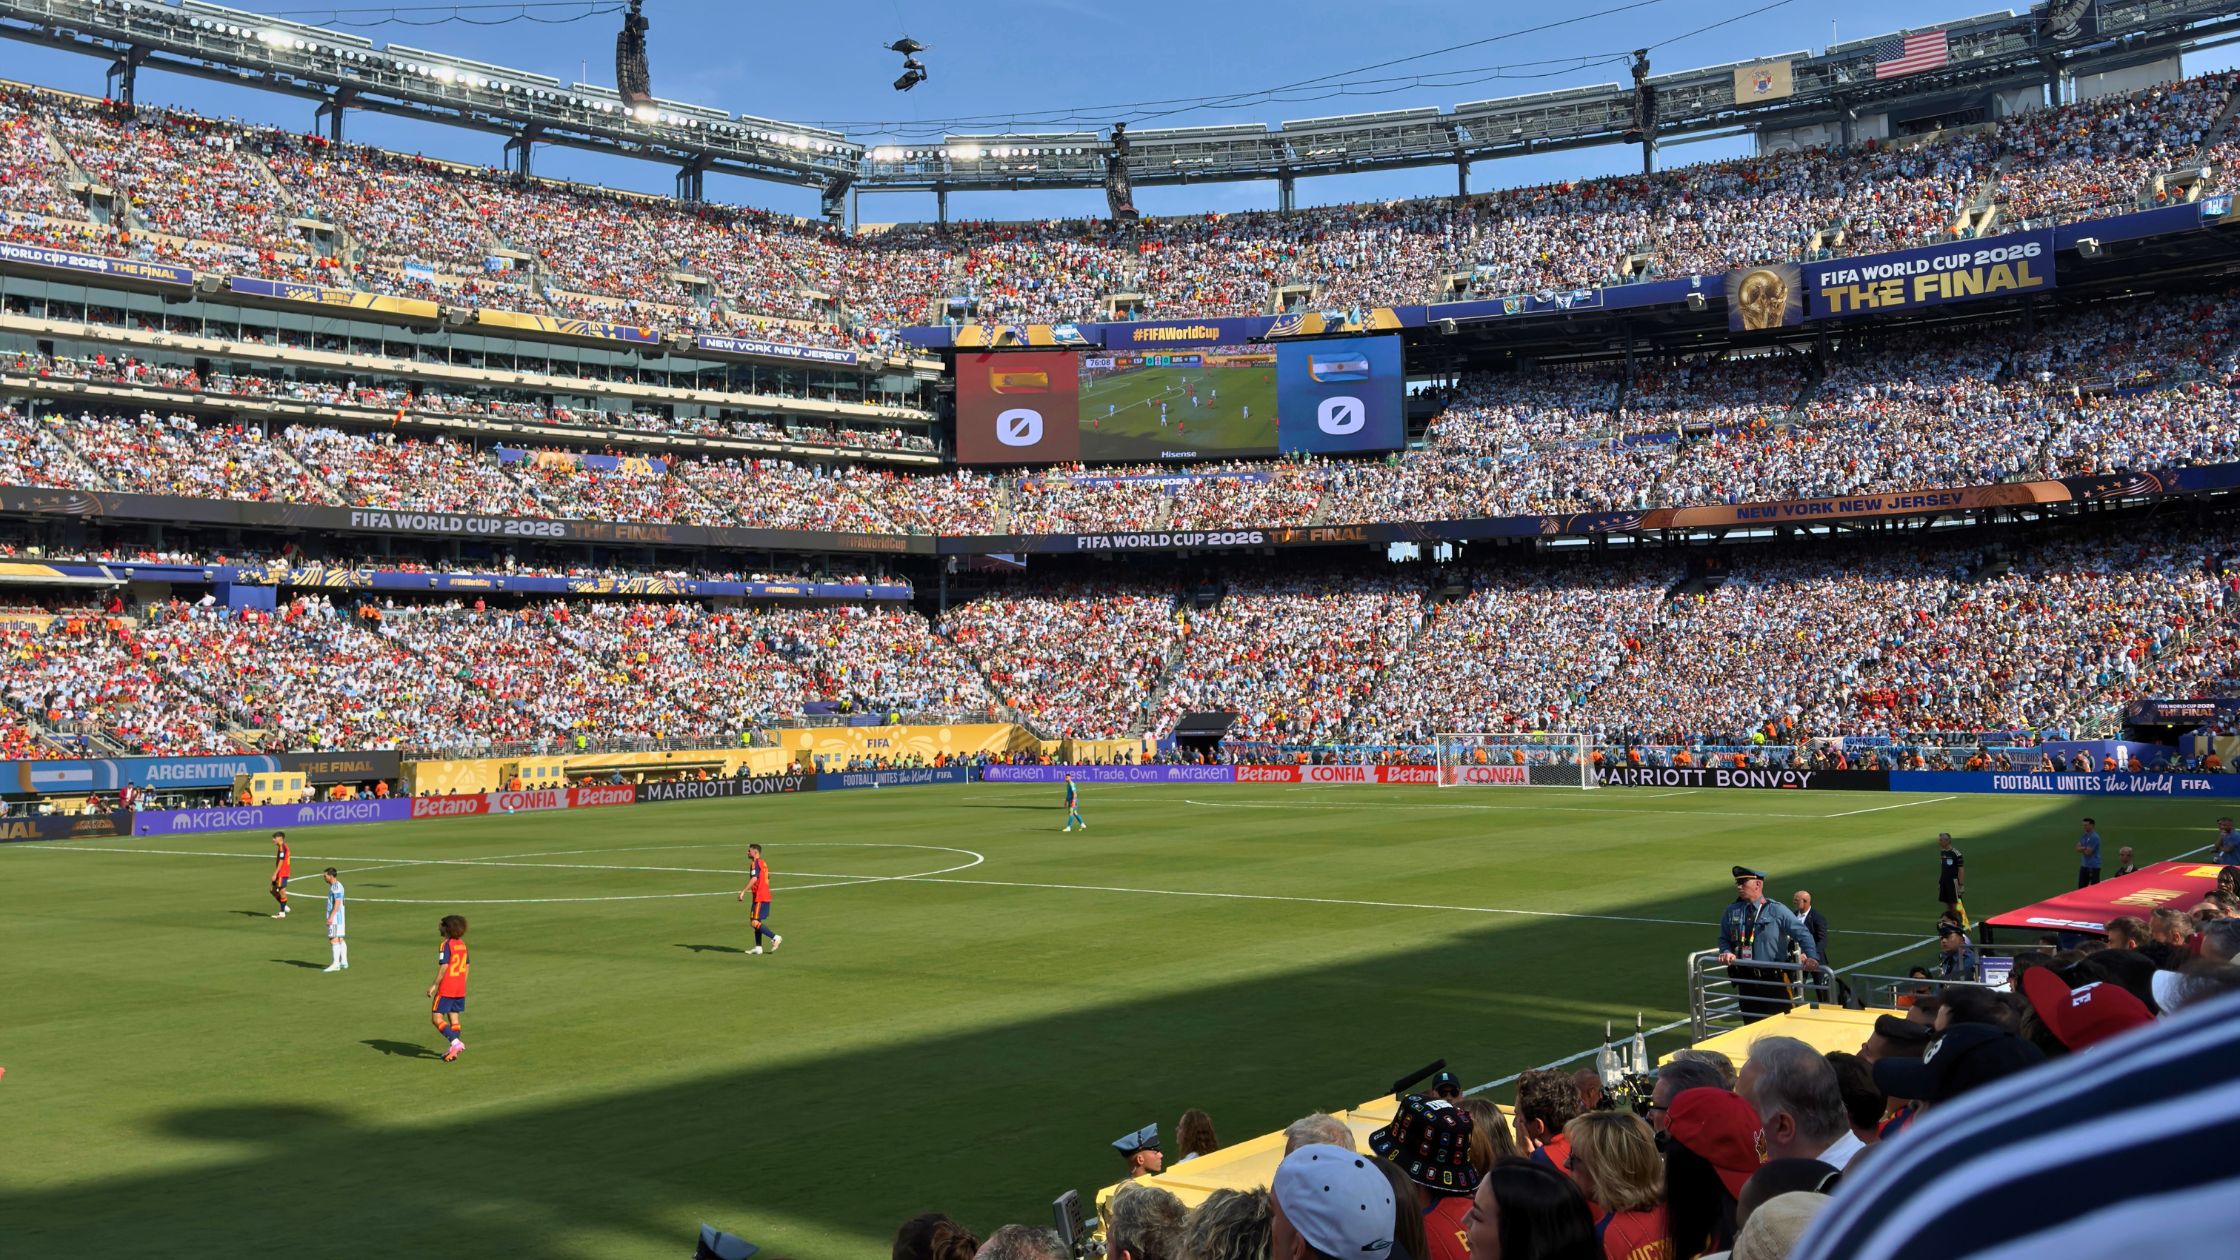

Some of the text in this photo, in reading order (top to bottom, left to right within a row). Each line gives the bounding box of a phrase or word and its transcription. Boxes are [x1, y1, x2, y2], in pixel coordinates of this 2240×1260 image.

[1, 247, 42, 260] WORLD
[44, 254, 67, 263] CUP
[112, 262, 138, 275] THE
[140, 264, 178, 280] FINAL
[1821, 242, 2041, 286] FIFA WORLD CUP 2026
[1821, 260, 2043, 313] THE FINAL
[1133, 325, 1220, 342] #FIFAWorldCup
[706, 338, 850, 361] NEW YORK NEW JERSEY
[1090, 359, 1111, 367] 76:08
[1317, 396, 1365, 435] 0
[996, 408, 1044, 447] 0
[1737, 492, 1964, 520] NEW YORK NEW JERSEY
[351, 512, 672, 541] FIFA WORLD CUP 2026 THE FINAL
[1077, 536, 1111, 549] FIFA
[1112, 534, 1171, 549] WORLD
[1173, 532, 1205, 546] CUP
[1207, 531, 1263, 545] 2026
[1310, 527, 1368, 542] FINAL
[2181, 708, 2214, 716] FINAL
[867, 738, 890, 748] FIFA
[1845, 738, 1872, 746] LOMAS
[146, 760, 375, 780] ARGENTINA THE FINAL
[843, 769, 952, 786] FOOTBALL UNITES the World FIFA
[1001, 767, 1229, 781] kraken Invest, Trade, Own kraken
[1237, 766, 1291, 782] Betano
[1311, 766, 1365, 782] CONFIA
[1466, 767, 1525, 783] CONFIA
[648, 779, 736, 800] MARRIOTT
[1993, 774, 2212, 794] FOOTBALL UNITES the World FIFA
[413, 788, 633, 817] Betano CONFIA Betano
[193, 803, 381, 828] kraken kraken
[450, 953, 467, 976] 24
